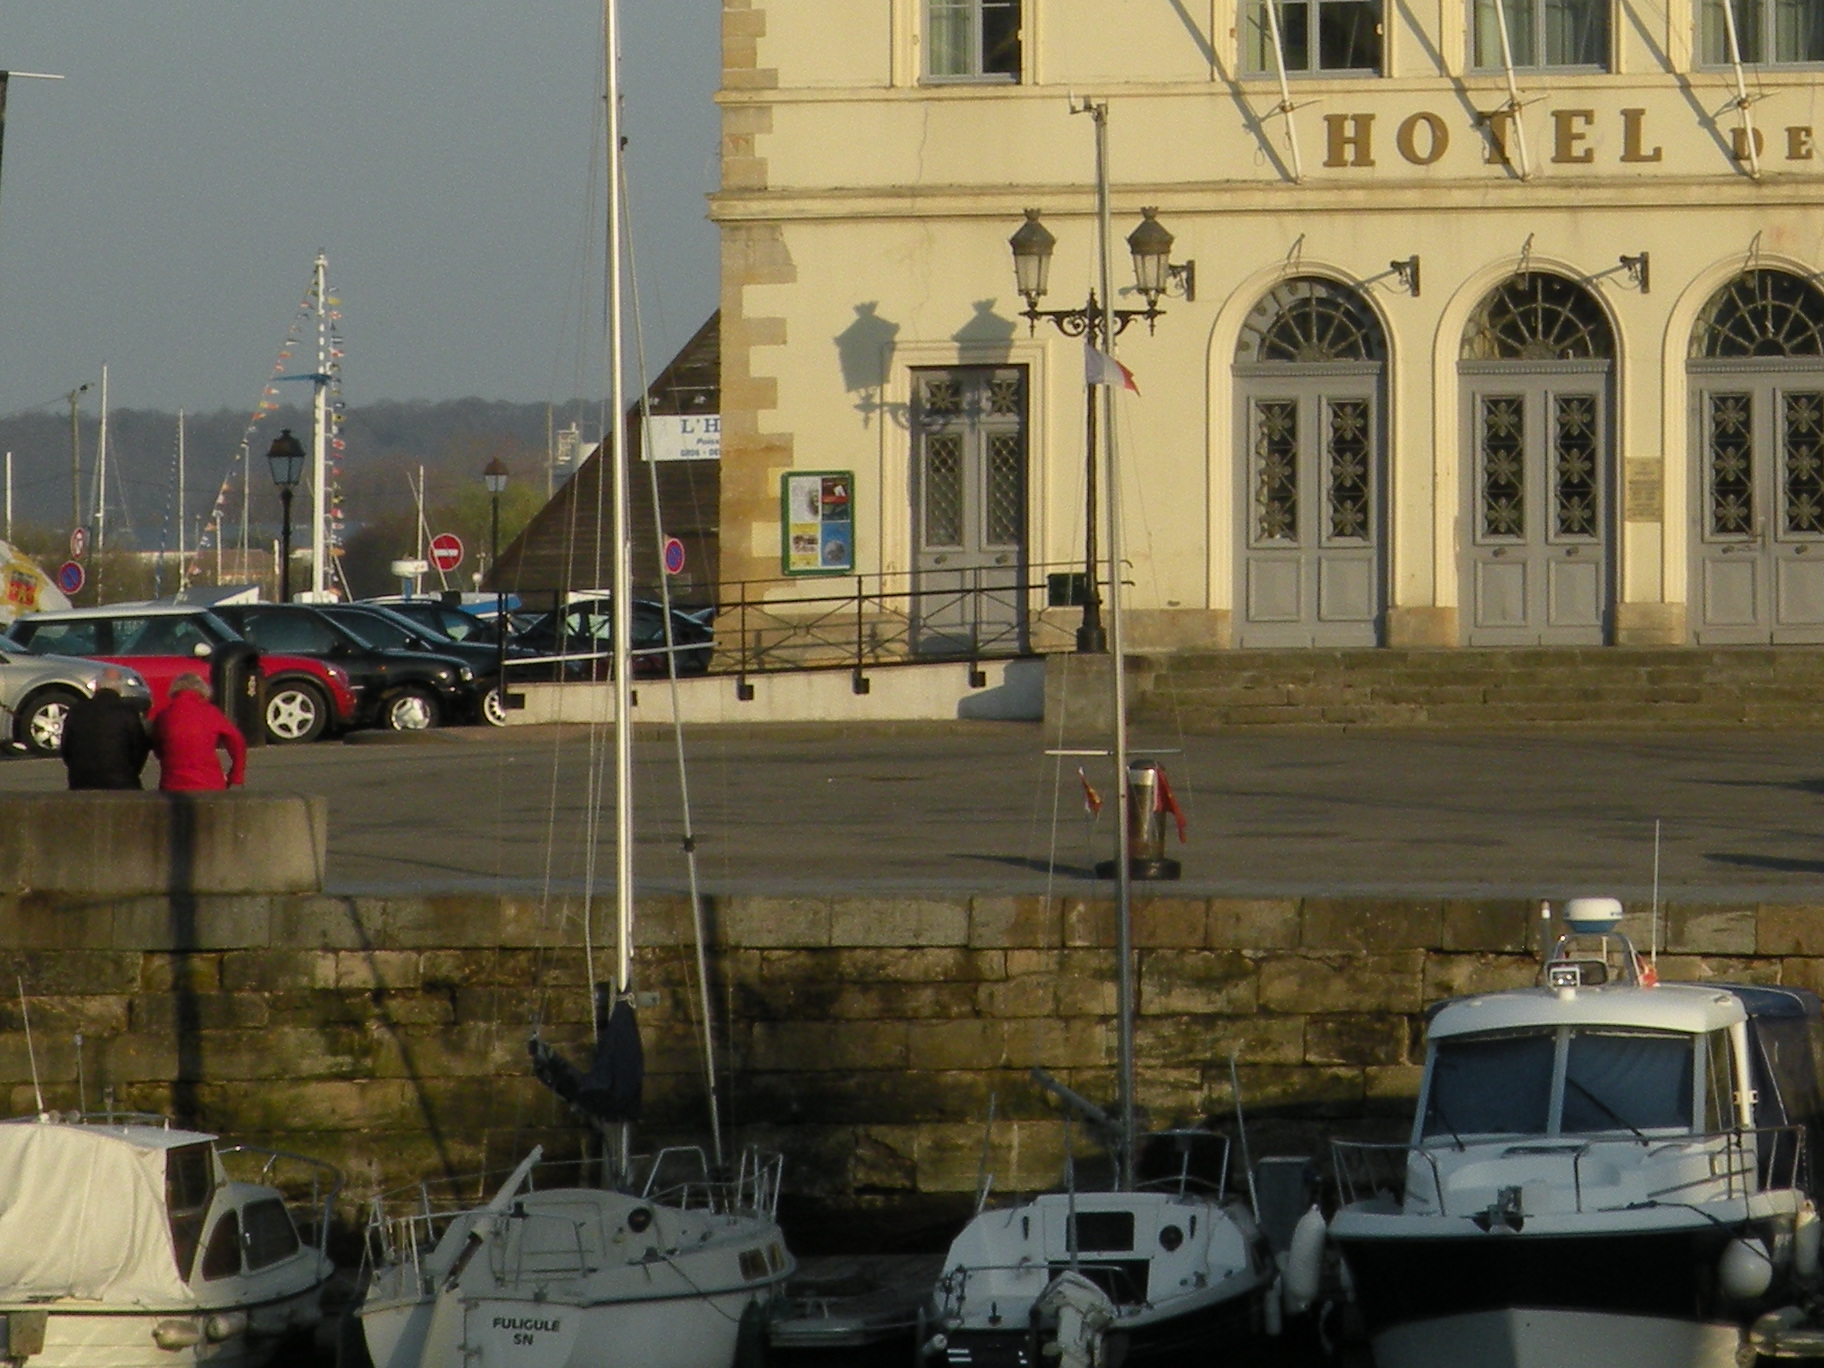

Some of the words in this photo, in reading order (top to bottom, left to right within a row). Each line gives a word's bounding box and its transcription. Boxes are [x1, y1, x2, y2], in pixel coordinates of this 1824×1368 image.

[1323, 108, 1662, 167] HOTEL
[1731, 126, 1813, 160] DE
[493, 1317, 560, 1332] FULIGULE
[513, 1333, 534, 1345] SN
